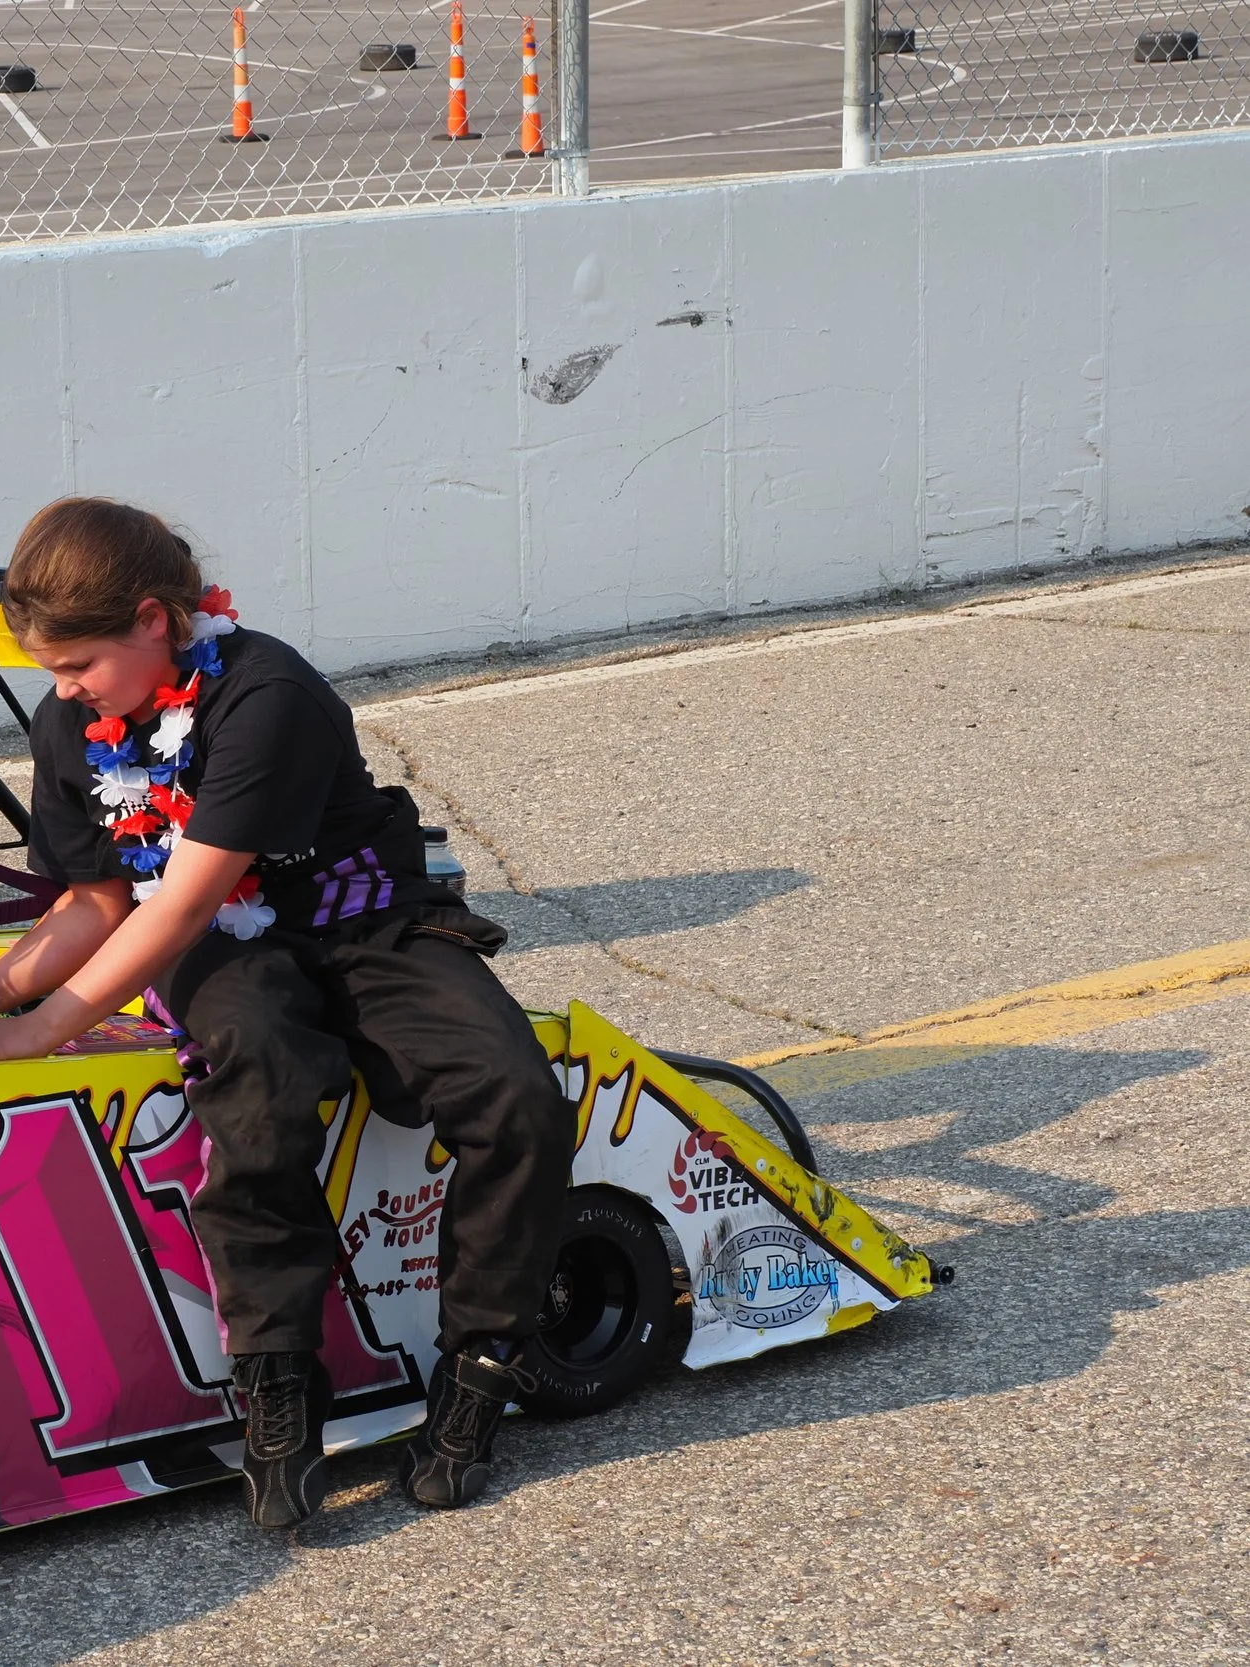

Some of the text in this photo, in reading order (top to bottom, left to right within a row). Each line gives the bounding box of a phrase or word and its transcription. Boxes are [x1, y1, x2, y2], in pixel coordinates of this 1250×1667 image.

[377, 1178, 445, 1216] BOUNC
[698, 1187, 759, 1212] TECH
[383, 1215, 437, 1248] HOUS
[400, 1255, 441, 1273] RENTA
[699, 1251, 841, 1302] Ruty Baker
[735, 1294, 816, 1324] OOLING
